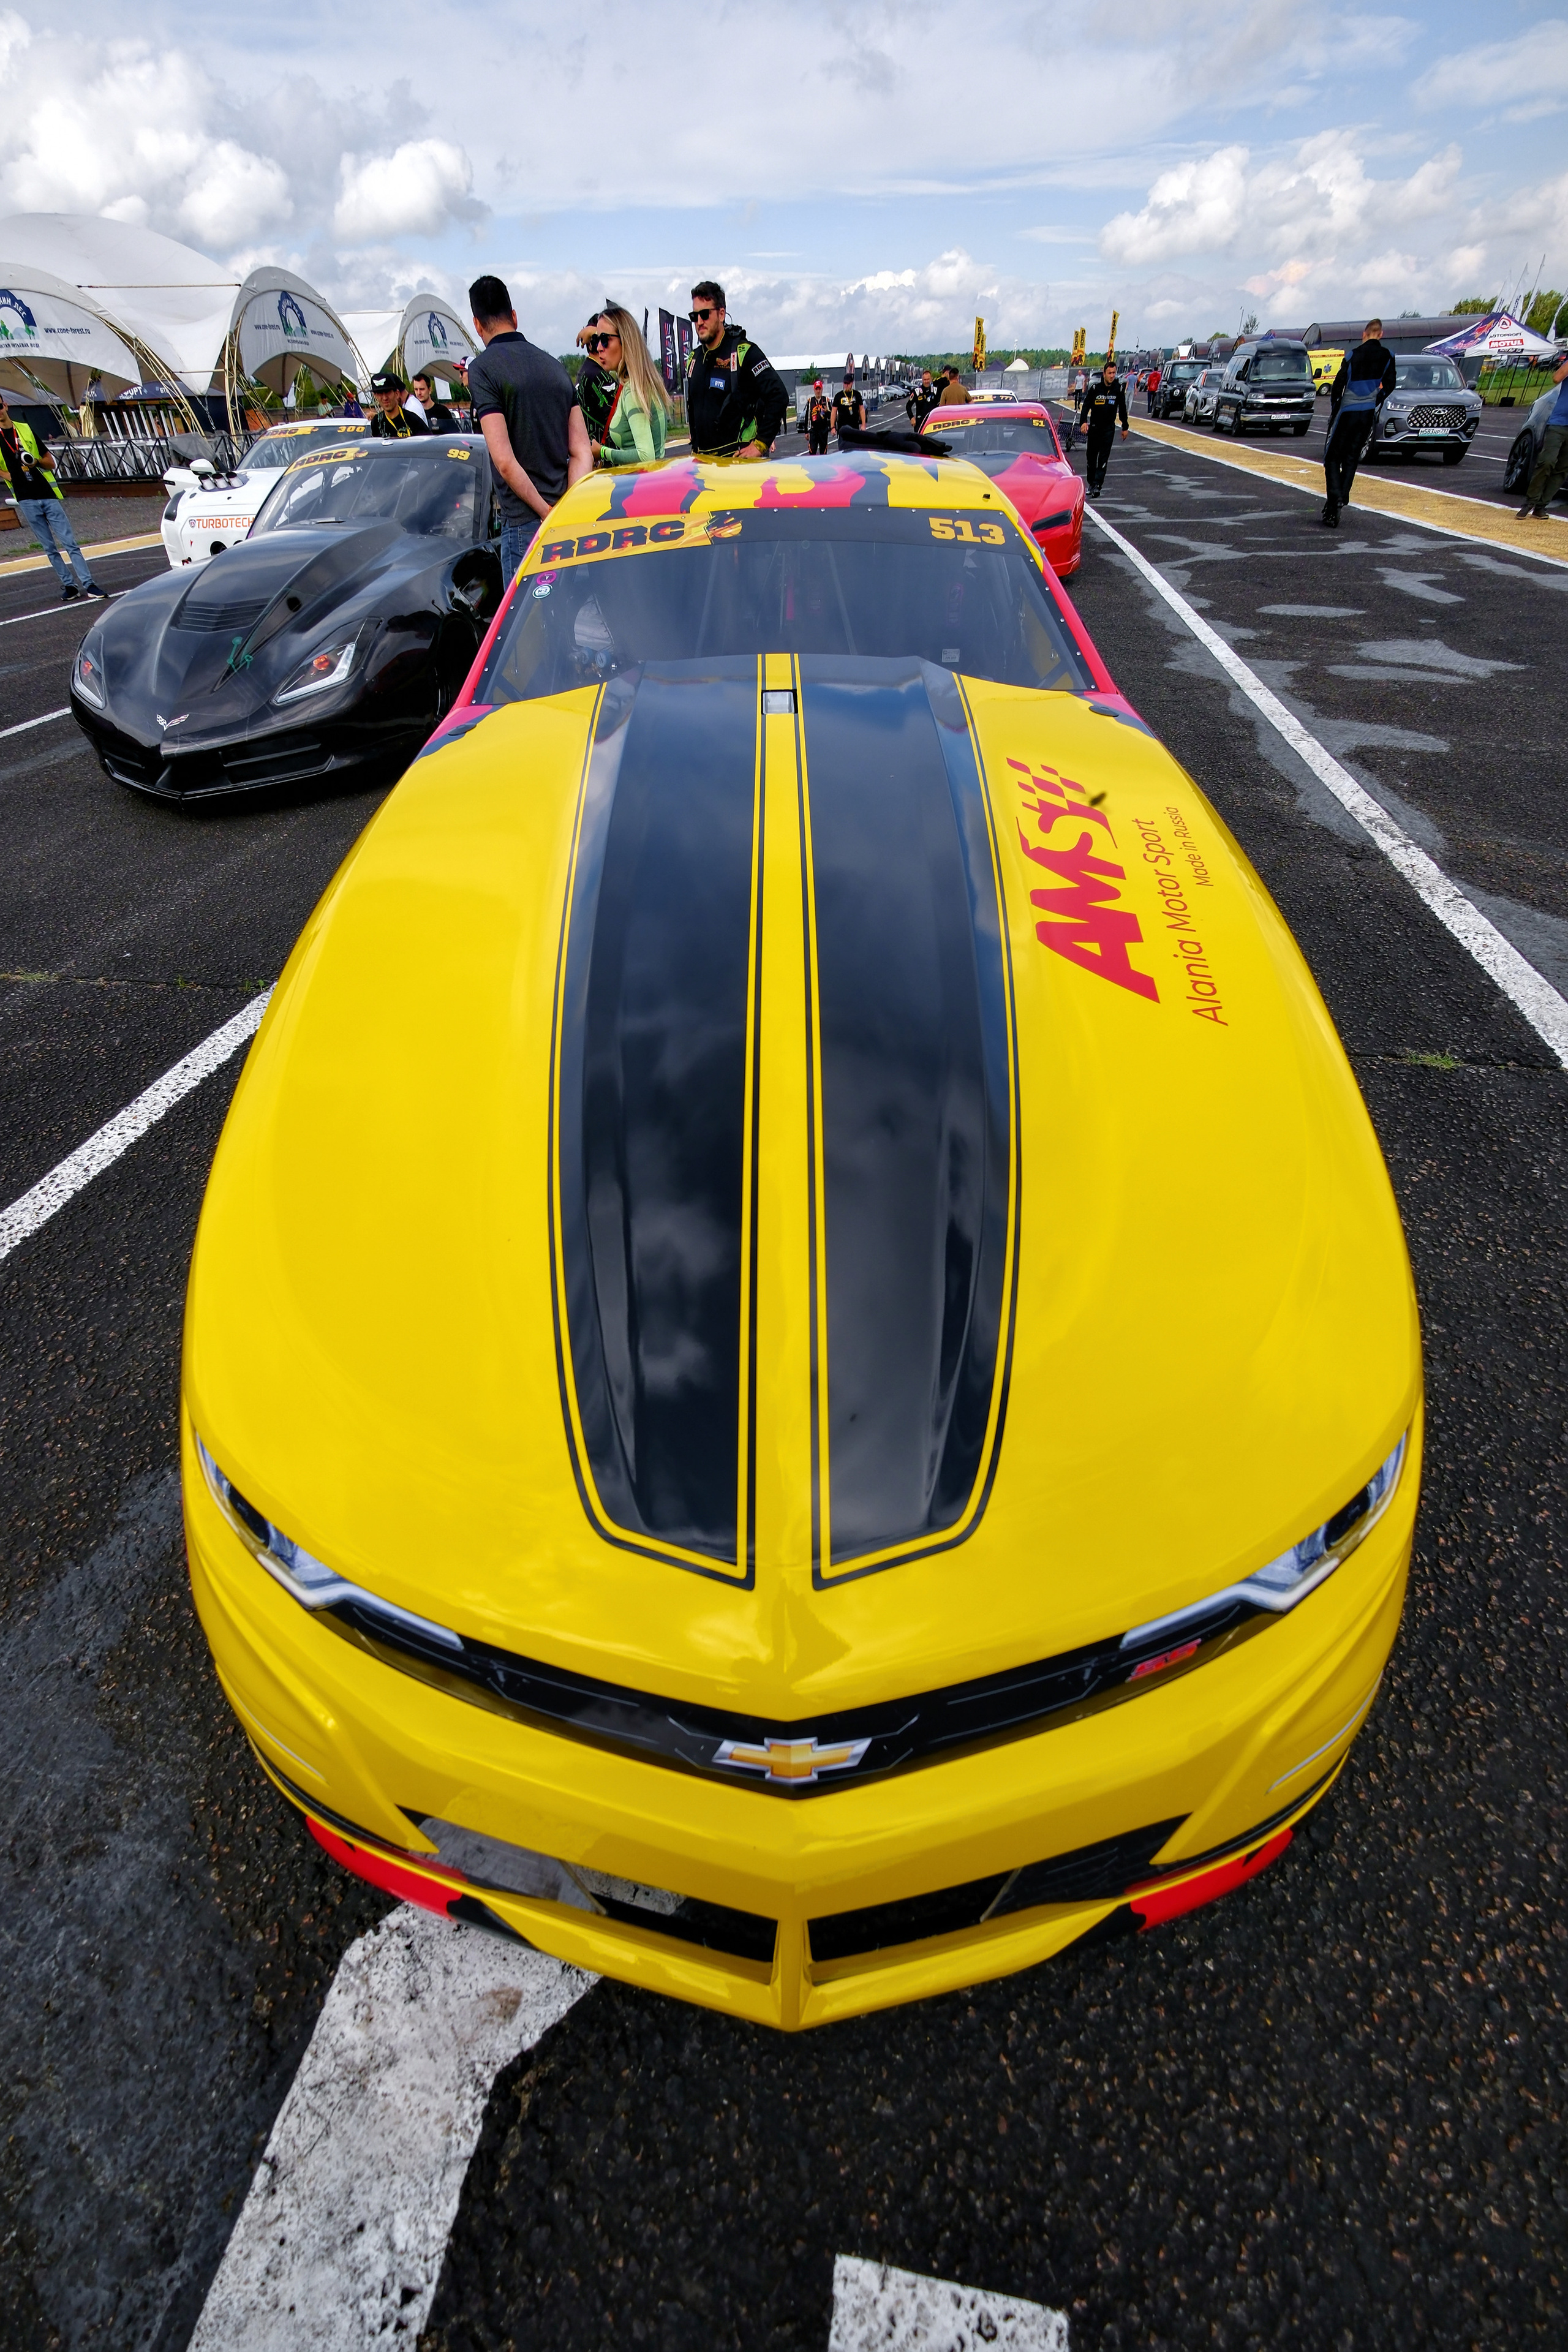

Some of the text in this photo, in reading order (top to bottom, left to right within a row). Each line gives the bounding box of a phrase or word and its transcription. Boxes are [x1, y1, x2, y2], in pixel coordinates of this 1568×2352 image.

[13, 302, 26, 318] ЛЕС
[1490, 339, 1522, 348] MOTUL
[933, 420, 970, 430] RDRC
[293, 448, 470, 469] RDRC 99
[197, 517, 254, 529] TURBOTECH
[540, 517, 1006, 564] RDRC 513
[1164, 806, 1214, 887] Made in Russia
[1016, 790, 1160, 1004] AMS
[1132, 818, 1229, 1027] Alania Motor Sport
